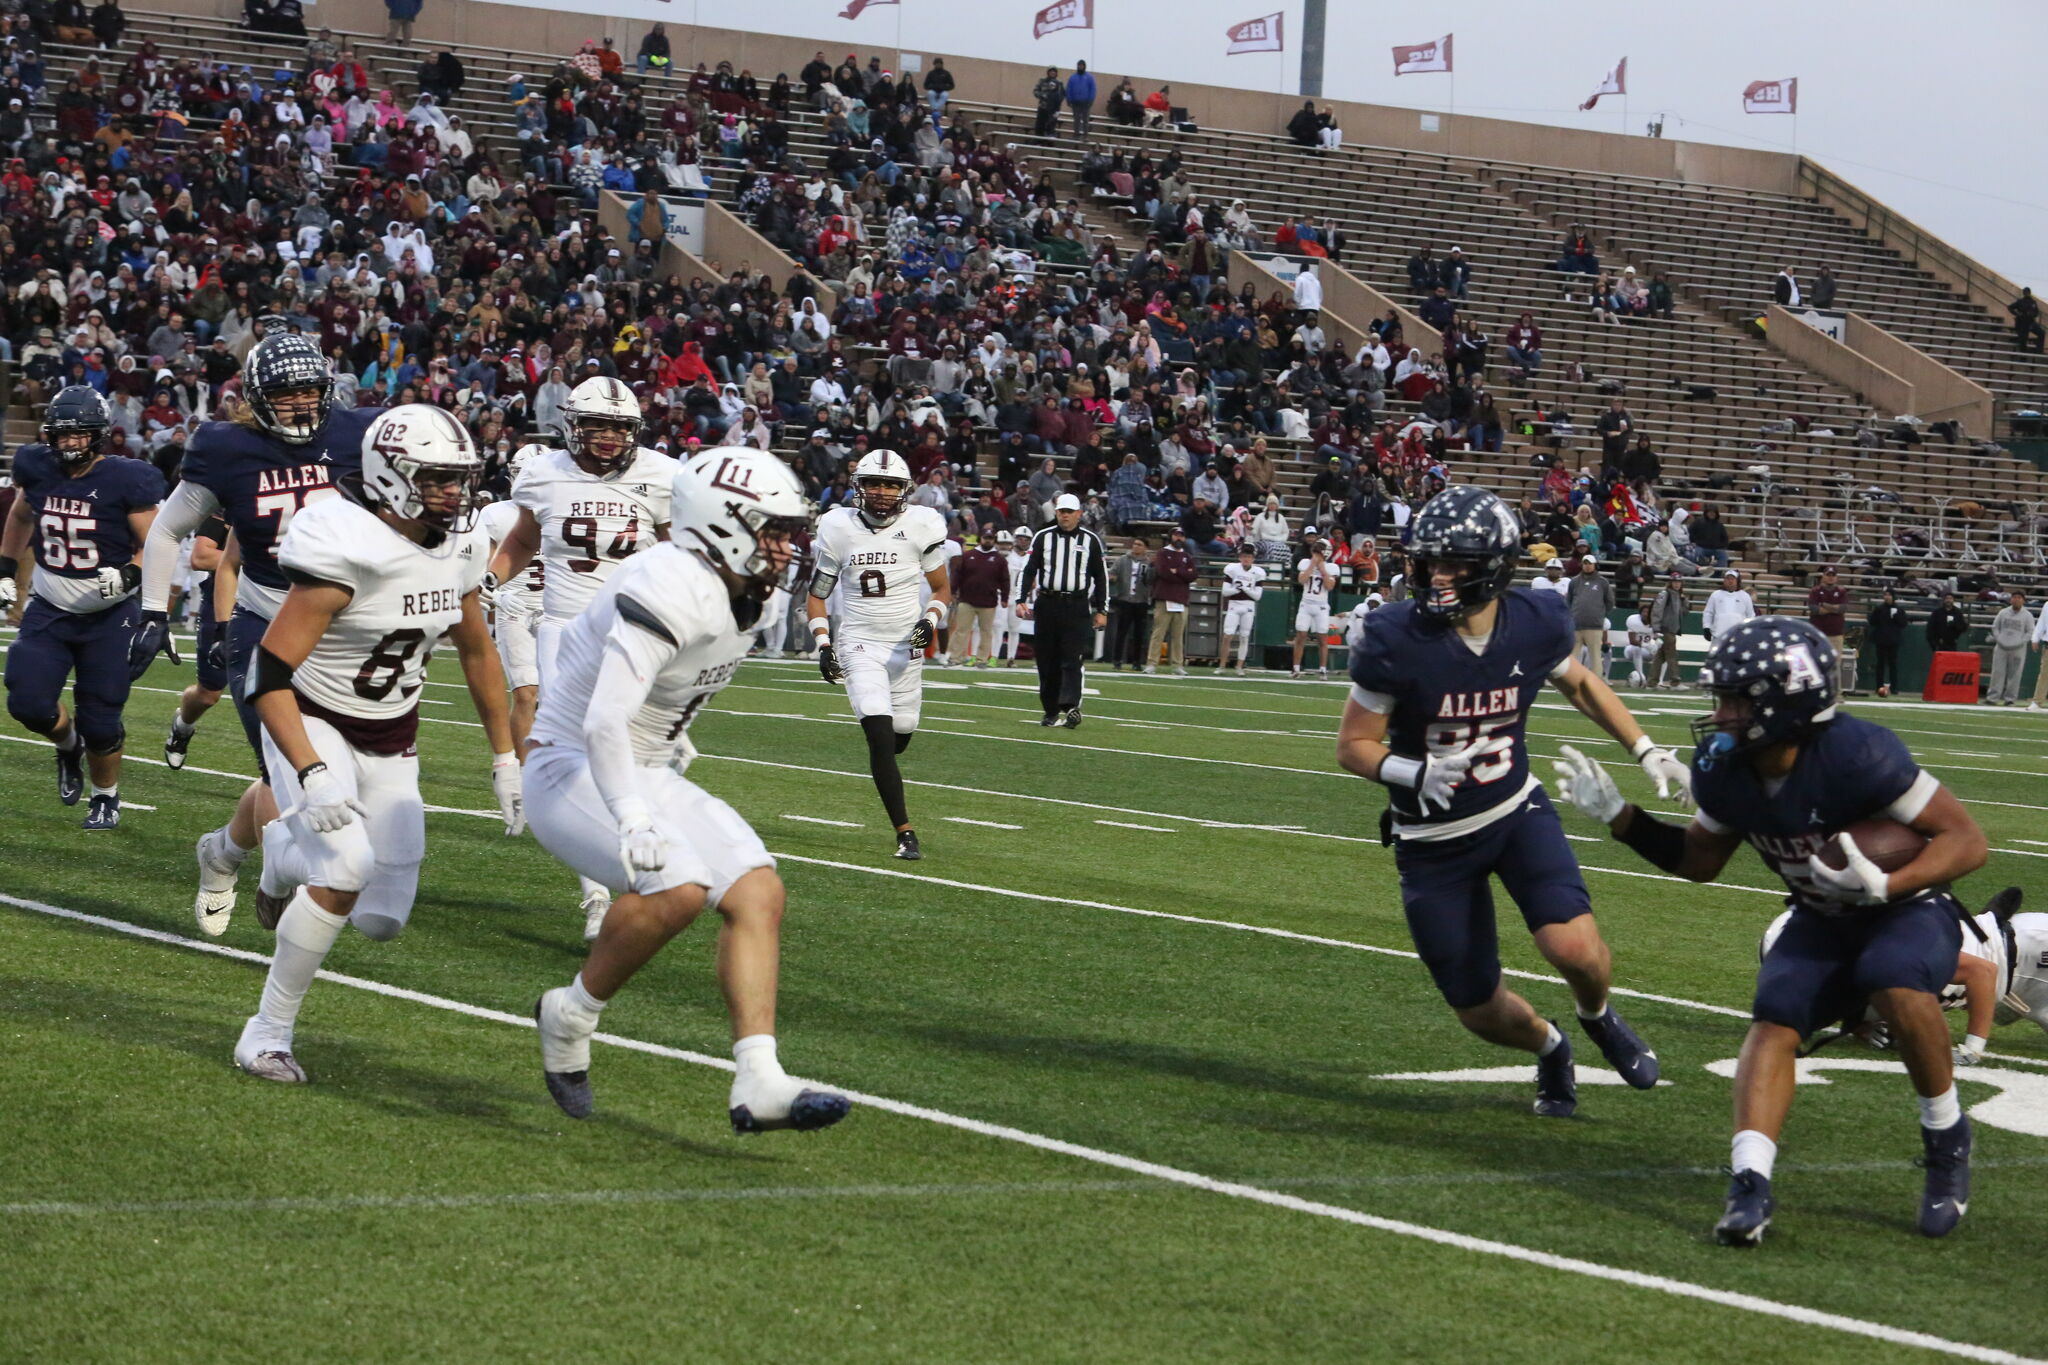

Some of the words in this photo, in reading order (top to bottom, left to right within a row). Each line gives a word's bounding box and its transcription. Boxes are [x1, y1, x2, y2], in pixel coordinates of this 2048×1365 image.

[259, 464, 329, 492] ALLEN
[43, 495, 91, 517] ALLEN
[571, 501, 638, 518] REBELS
[40, 514, 99, 569] 65
[562, 517, 640, 573] 94
[849, 552, 898, 567] REBELS
[402, 588, 462, 616] REBEL
[1783, 642, 1826, 695] A
[1941, 672, 1975, 686] GILL
[1437, 686, 1519, 717] ALLEN
